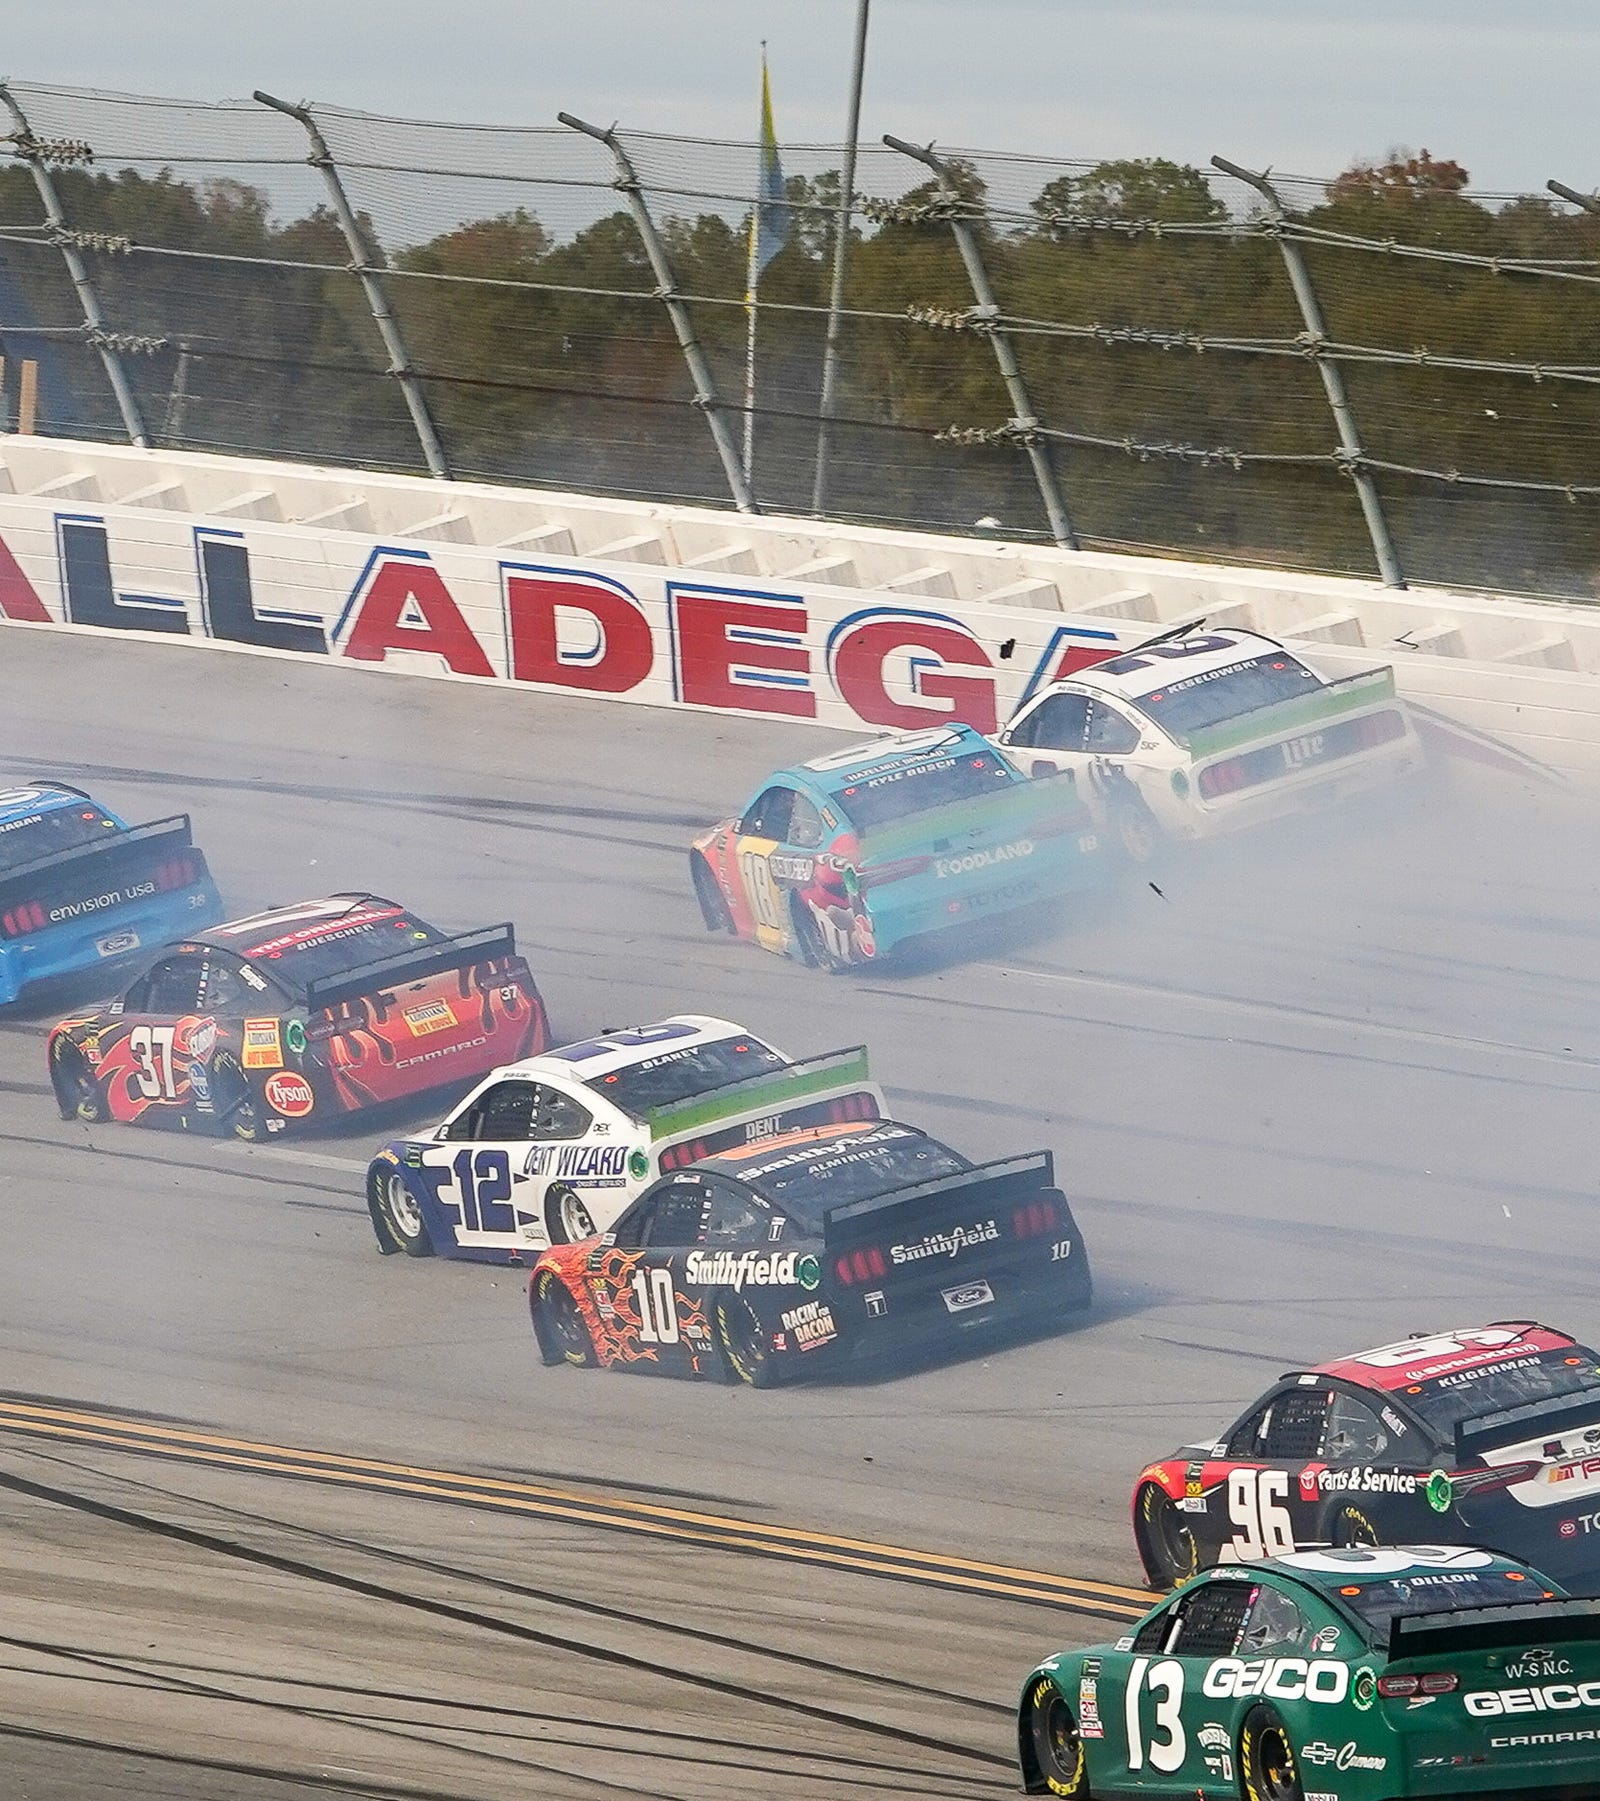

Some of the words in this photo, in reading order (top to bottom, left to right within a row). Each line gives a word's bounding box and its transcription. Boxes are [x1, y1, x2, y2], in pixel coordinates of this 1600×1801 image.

[1167, 660, 1258, 694] KESELOWSKI
[868, 770, 903, 788] KYLE
[906, 758, 957, 778] BUSCH
[934, 839, 1034, 879] FOODLAND
[49, 890, 121, 922] envision
[126, 880, 156, 900] usa
[500, 984, 518, 1001] 37
[131, 1026, 177, 1098] 37
[396, 1036, 488, 1070] CAMARO
[641, 1047, 701, 1071] BLANEY
[269, 1080, 313, 1108] Tyson
[746, 1115, 782, 1138] DENT
[808, 1147, 891, 1175] ALMIROLA
[453, 1149, 516, 1232] 12
[523, 1145, 554, 1177] DENT
[556, 1145, 629, 1177] WIZARD
[890, 1220, 1001, 1265] Smithfield
[1050, 1240, 1072, 1262] 10
[685, 1250, 800, 1293] Smithfield
[632, 1268, 680, 1344] 10
[794, 1314, 834, 1343] BACON
[1438, 1357, 1542, 1388] KLIGERMAN
[1228, 1468, 1296, 1562] 96
[1317, 1469, 1349, 1492] Parts
[1360, 1467, 1417, 1494] Service
[1409, 1573, 1479, 1588] DILLON
[1505, 1661, 1541, 1680] W-S
[1542, 1660, 1574, 1677] N.C.
[1124, 1656, 1188, 1773] 13
[1201, 1656, 1350, 1704] GEICO
[1490, 1730, 1600, 1748] CAMAR
[1336, 1741, 1387, 1771] Camaro
